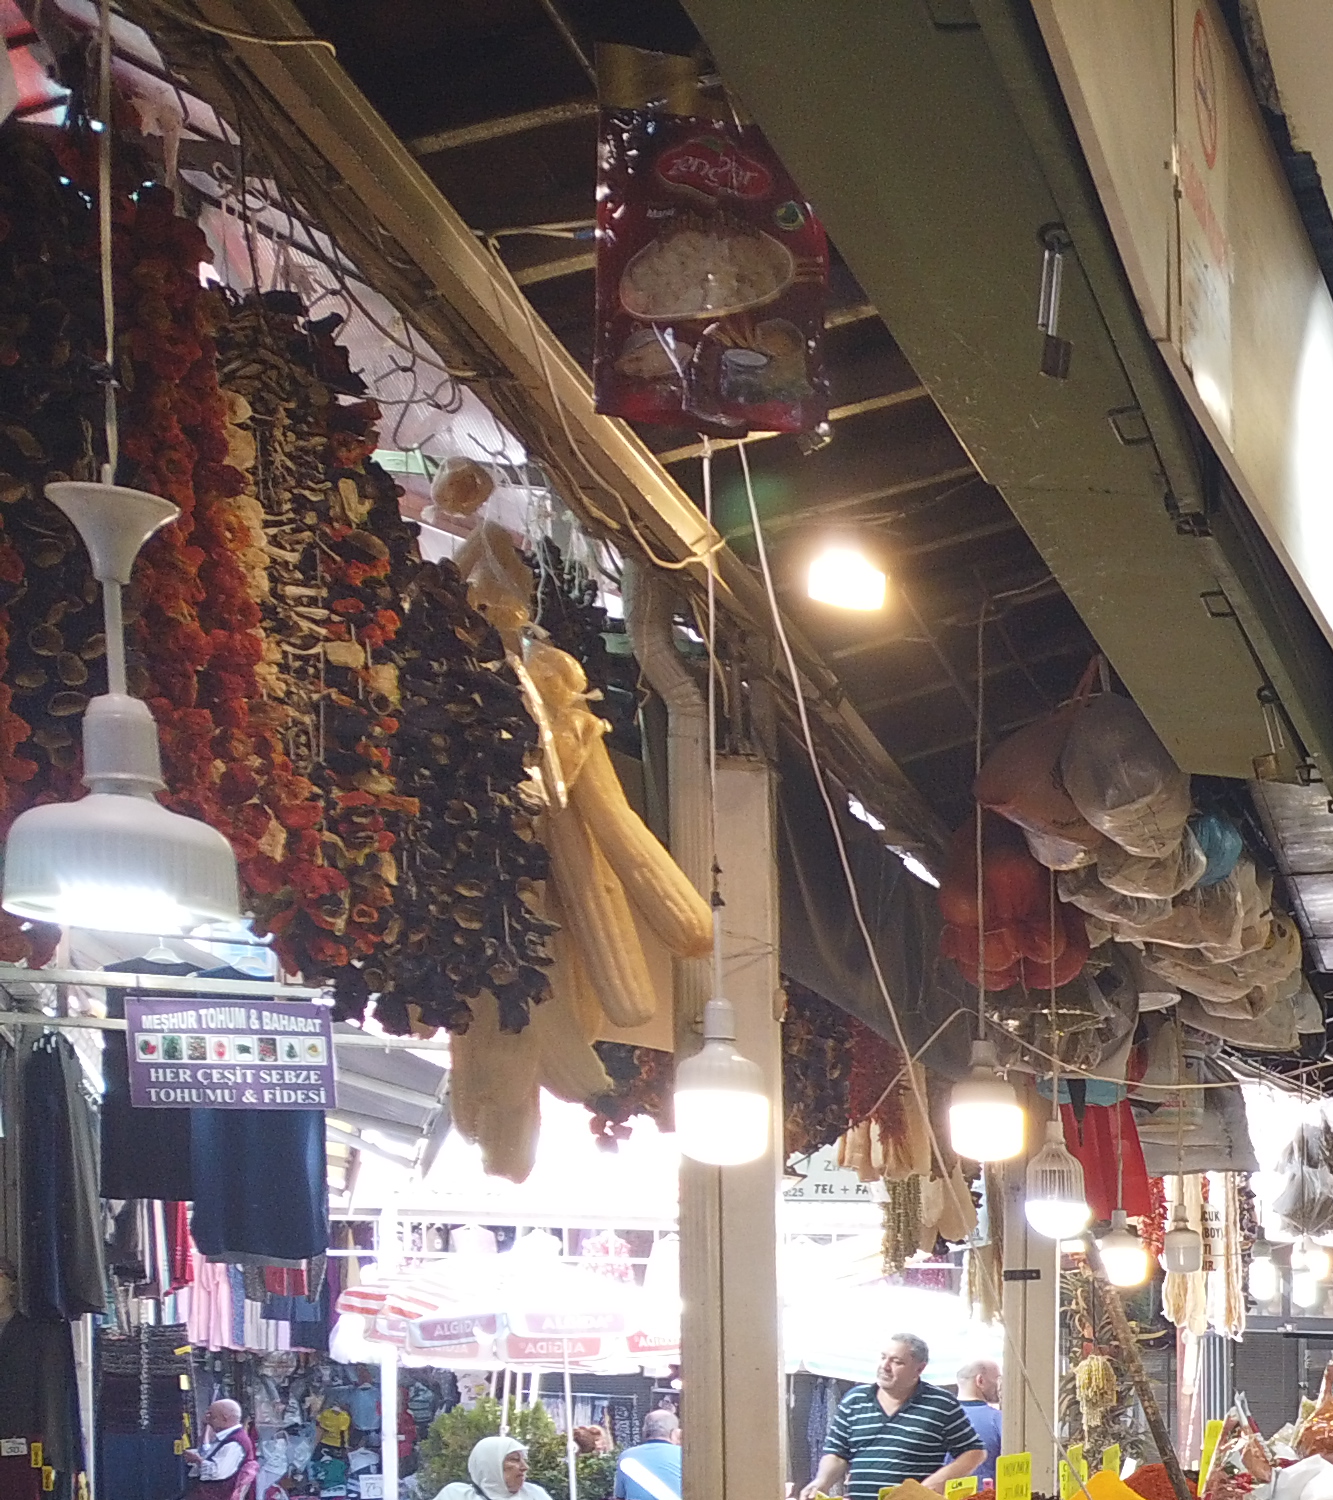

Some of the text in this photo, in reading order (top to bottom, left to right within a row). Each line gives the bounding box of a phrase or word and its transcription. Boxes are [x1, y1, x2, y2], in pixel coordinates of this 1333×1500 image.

[142, 1007, 322, 1033] MEŞHUR TOHUM & BAHARAT
[150, 1066, 322, 1086] HER ÇEŞİT SEBZE
[146, 1087, 326, 1104] TOHUMU & FİDESİ
[814, 1184, 834, 1194] TEL
[855, 1184, 869, 1194] FA
